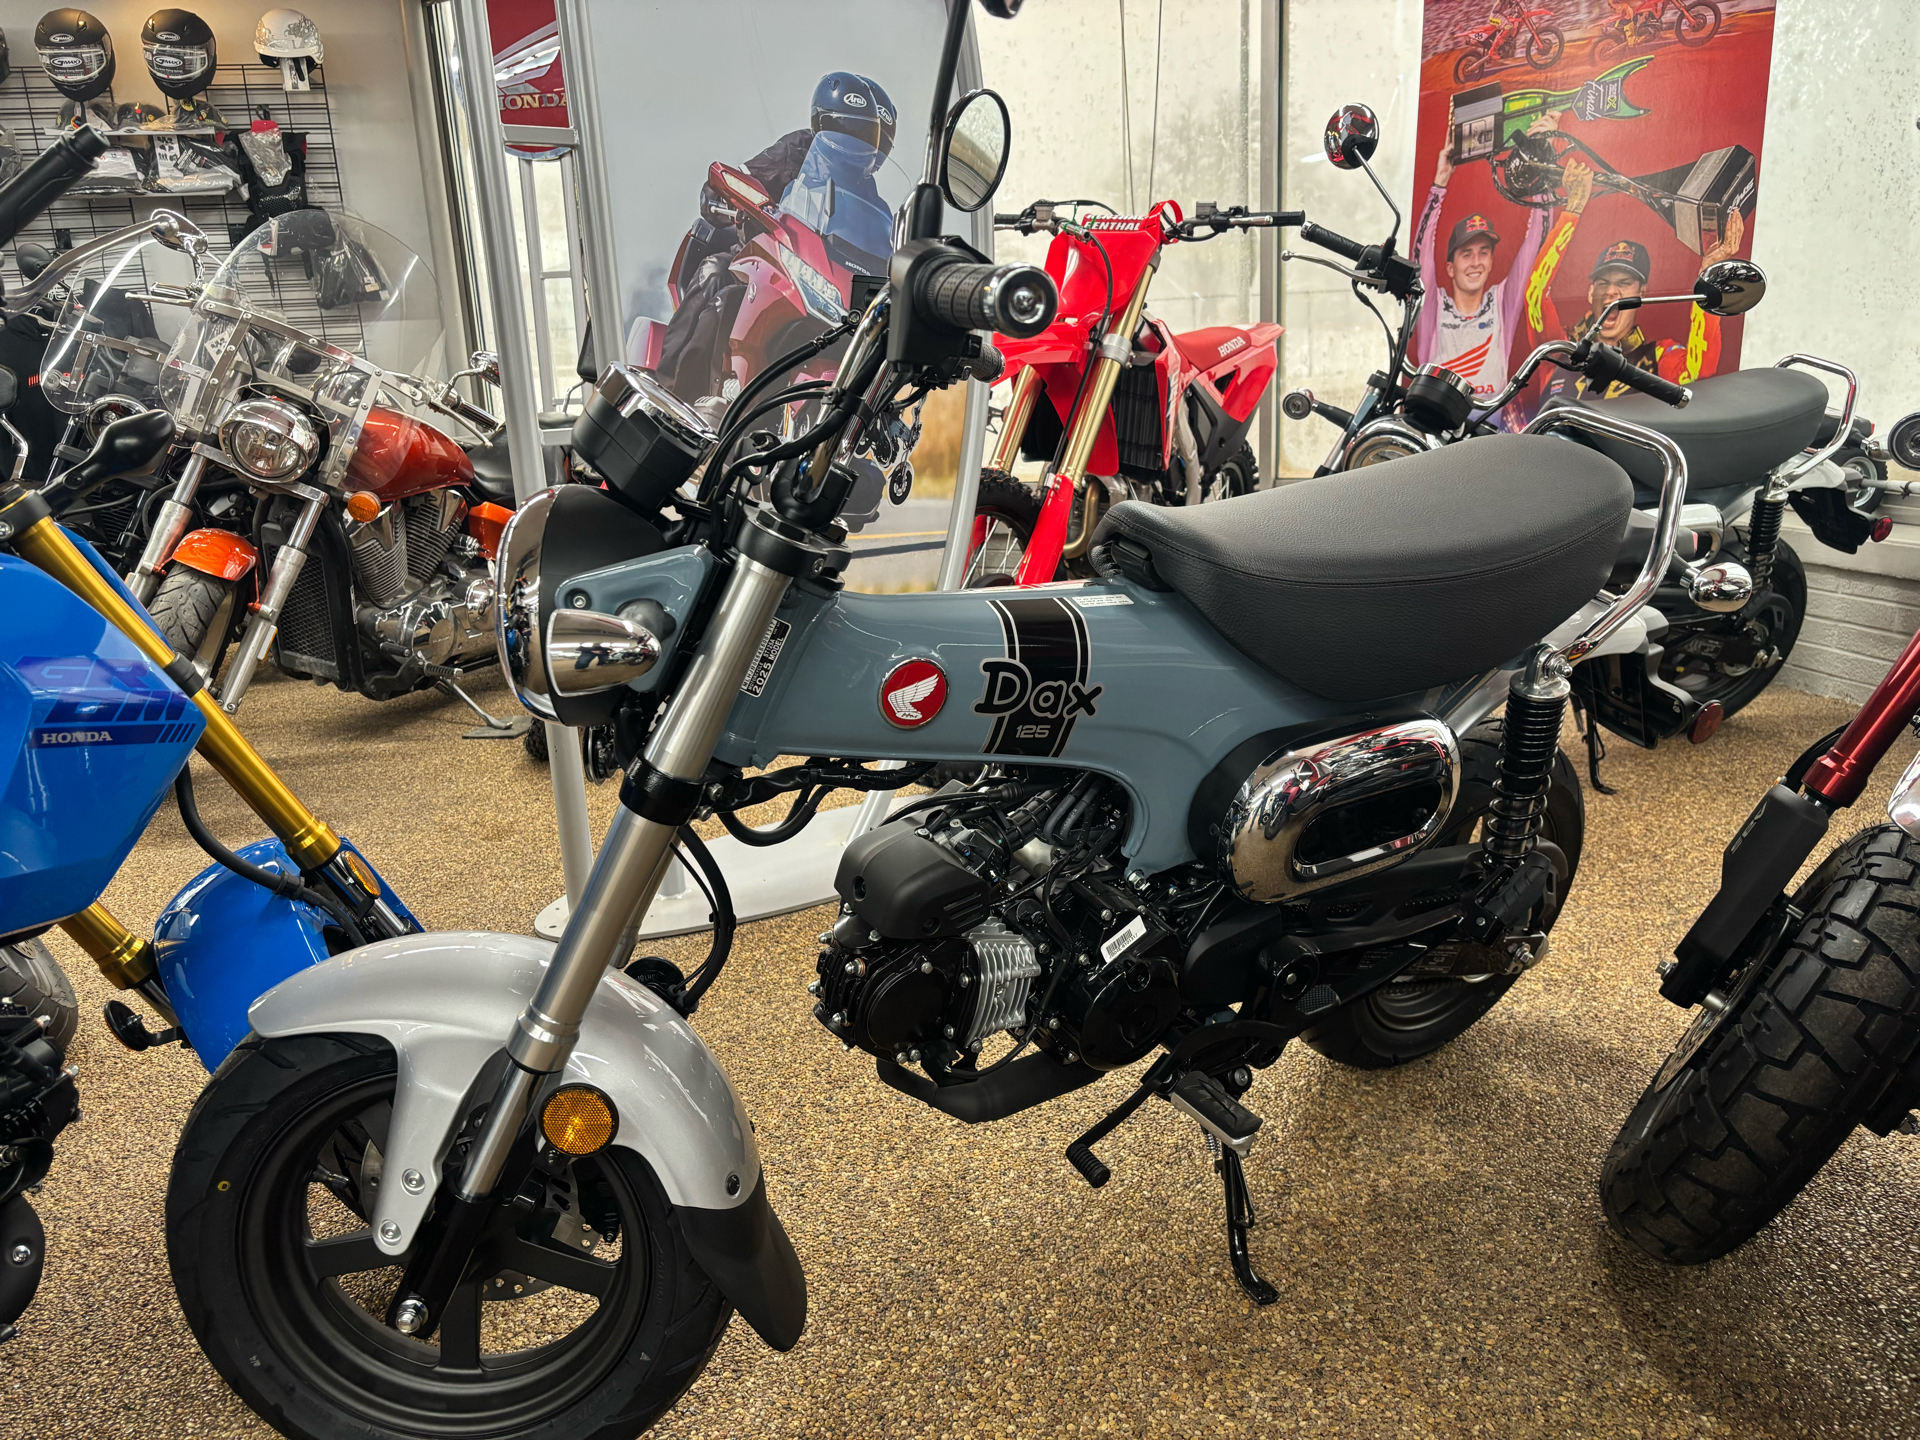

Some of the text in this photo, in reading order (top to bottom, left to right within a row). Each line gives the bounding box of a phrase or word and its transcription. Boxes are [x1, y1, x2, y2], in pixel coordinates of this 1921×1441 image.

[1217, 336, 1246, 357] HONDA
[753, 662, 772, 694] 2025
[769, 637, 784, 661] MODEL
[972, 658, 1105, 719] Dax
[41, 731, 113, 744] HONDA
[1015, 725, 1051, 739] 125
